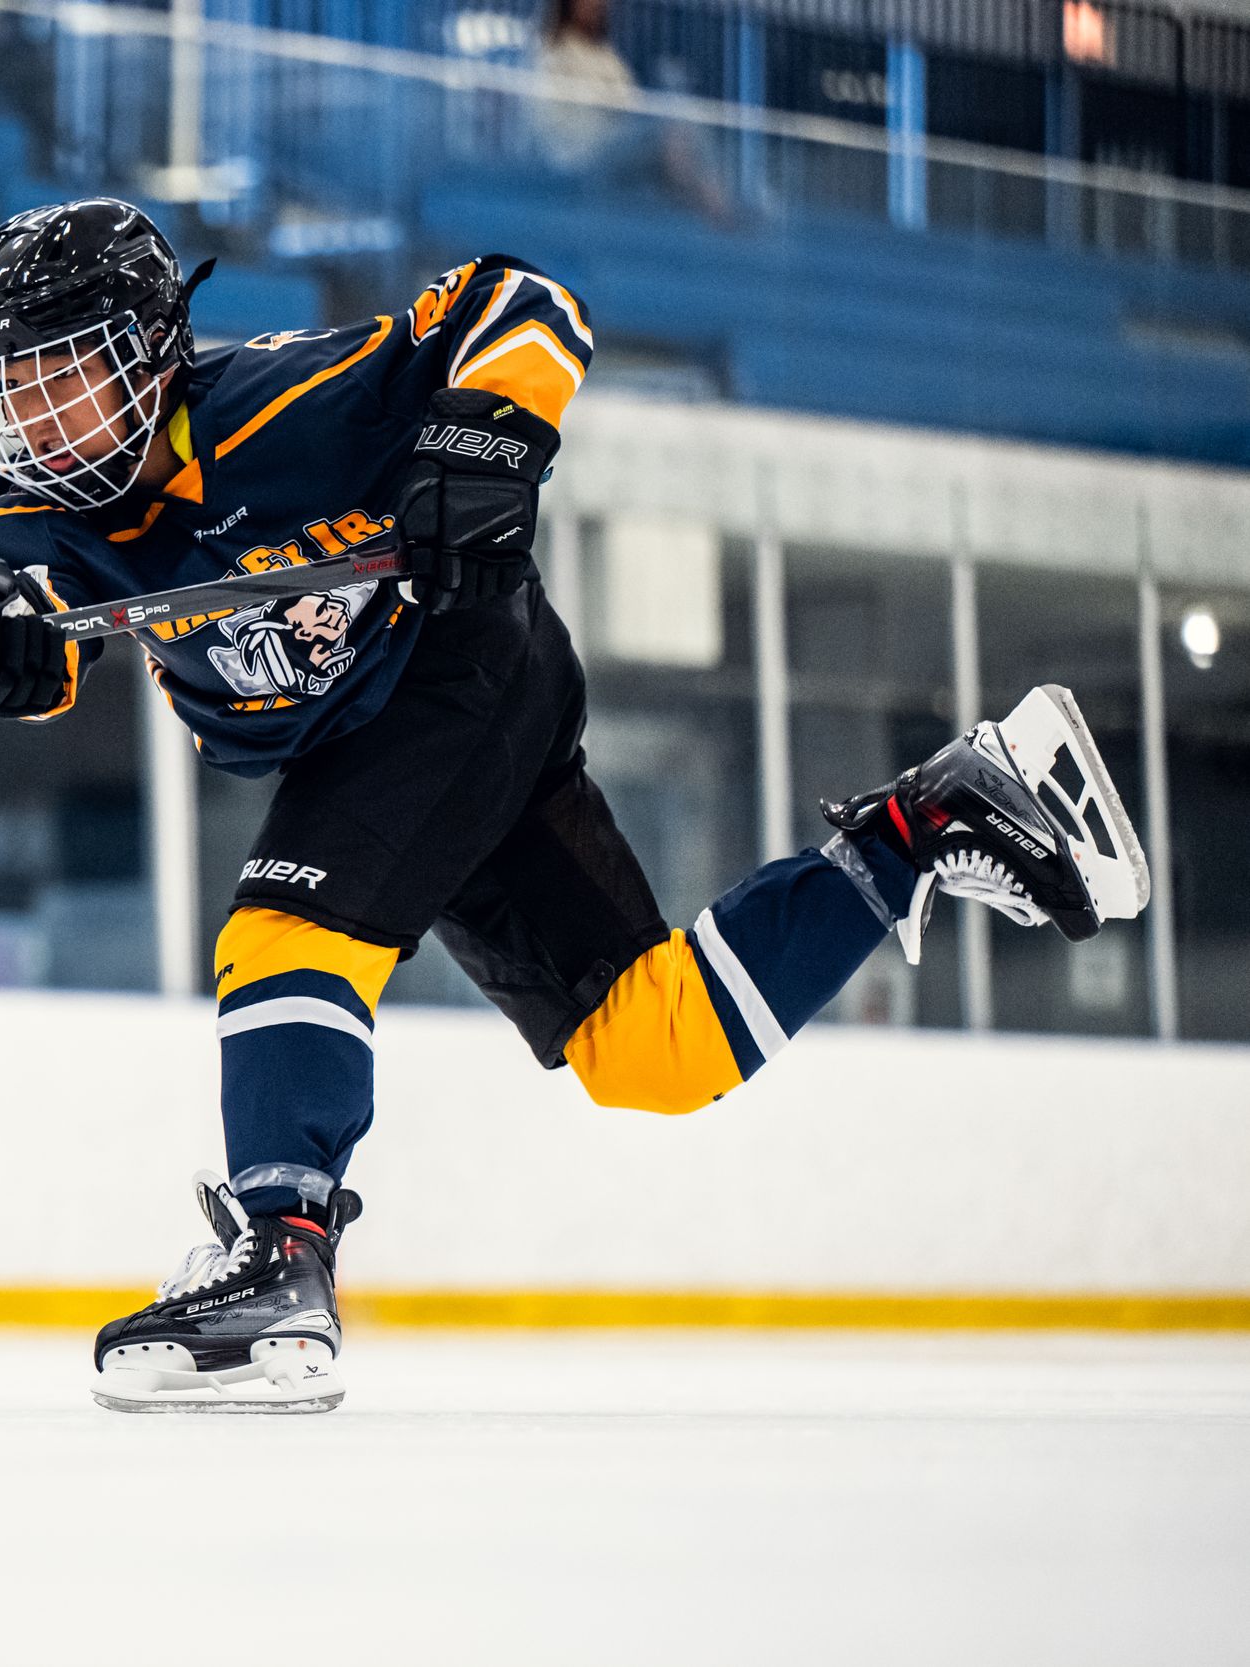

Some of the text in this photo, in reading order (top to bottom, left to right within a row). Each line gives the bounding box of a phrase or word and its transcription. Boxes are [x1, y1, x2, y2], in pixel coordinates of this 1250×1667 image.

[413, 424, 528, 469] UER
[44, 615, 111, 632] POR
[145, 604, 170, 616] PRO
[985, 812, 1048, 859] BAUER
[186, 1287, 255, 1314] BAUER
